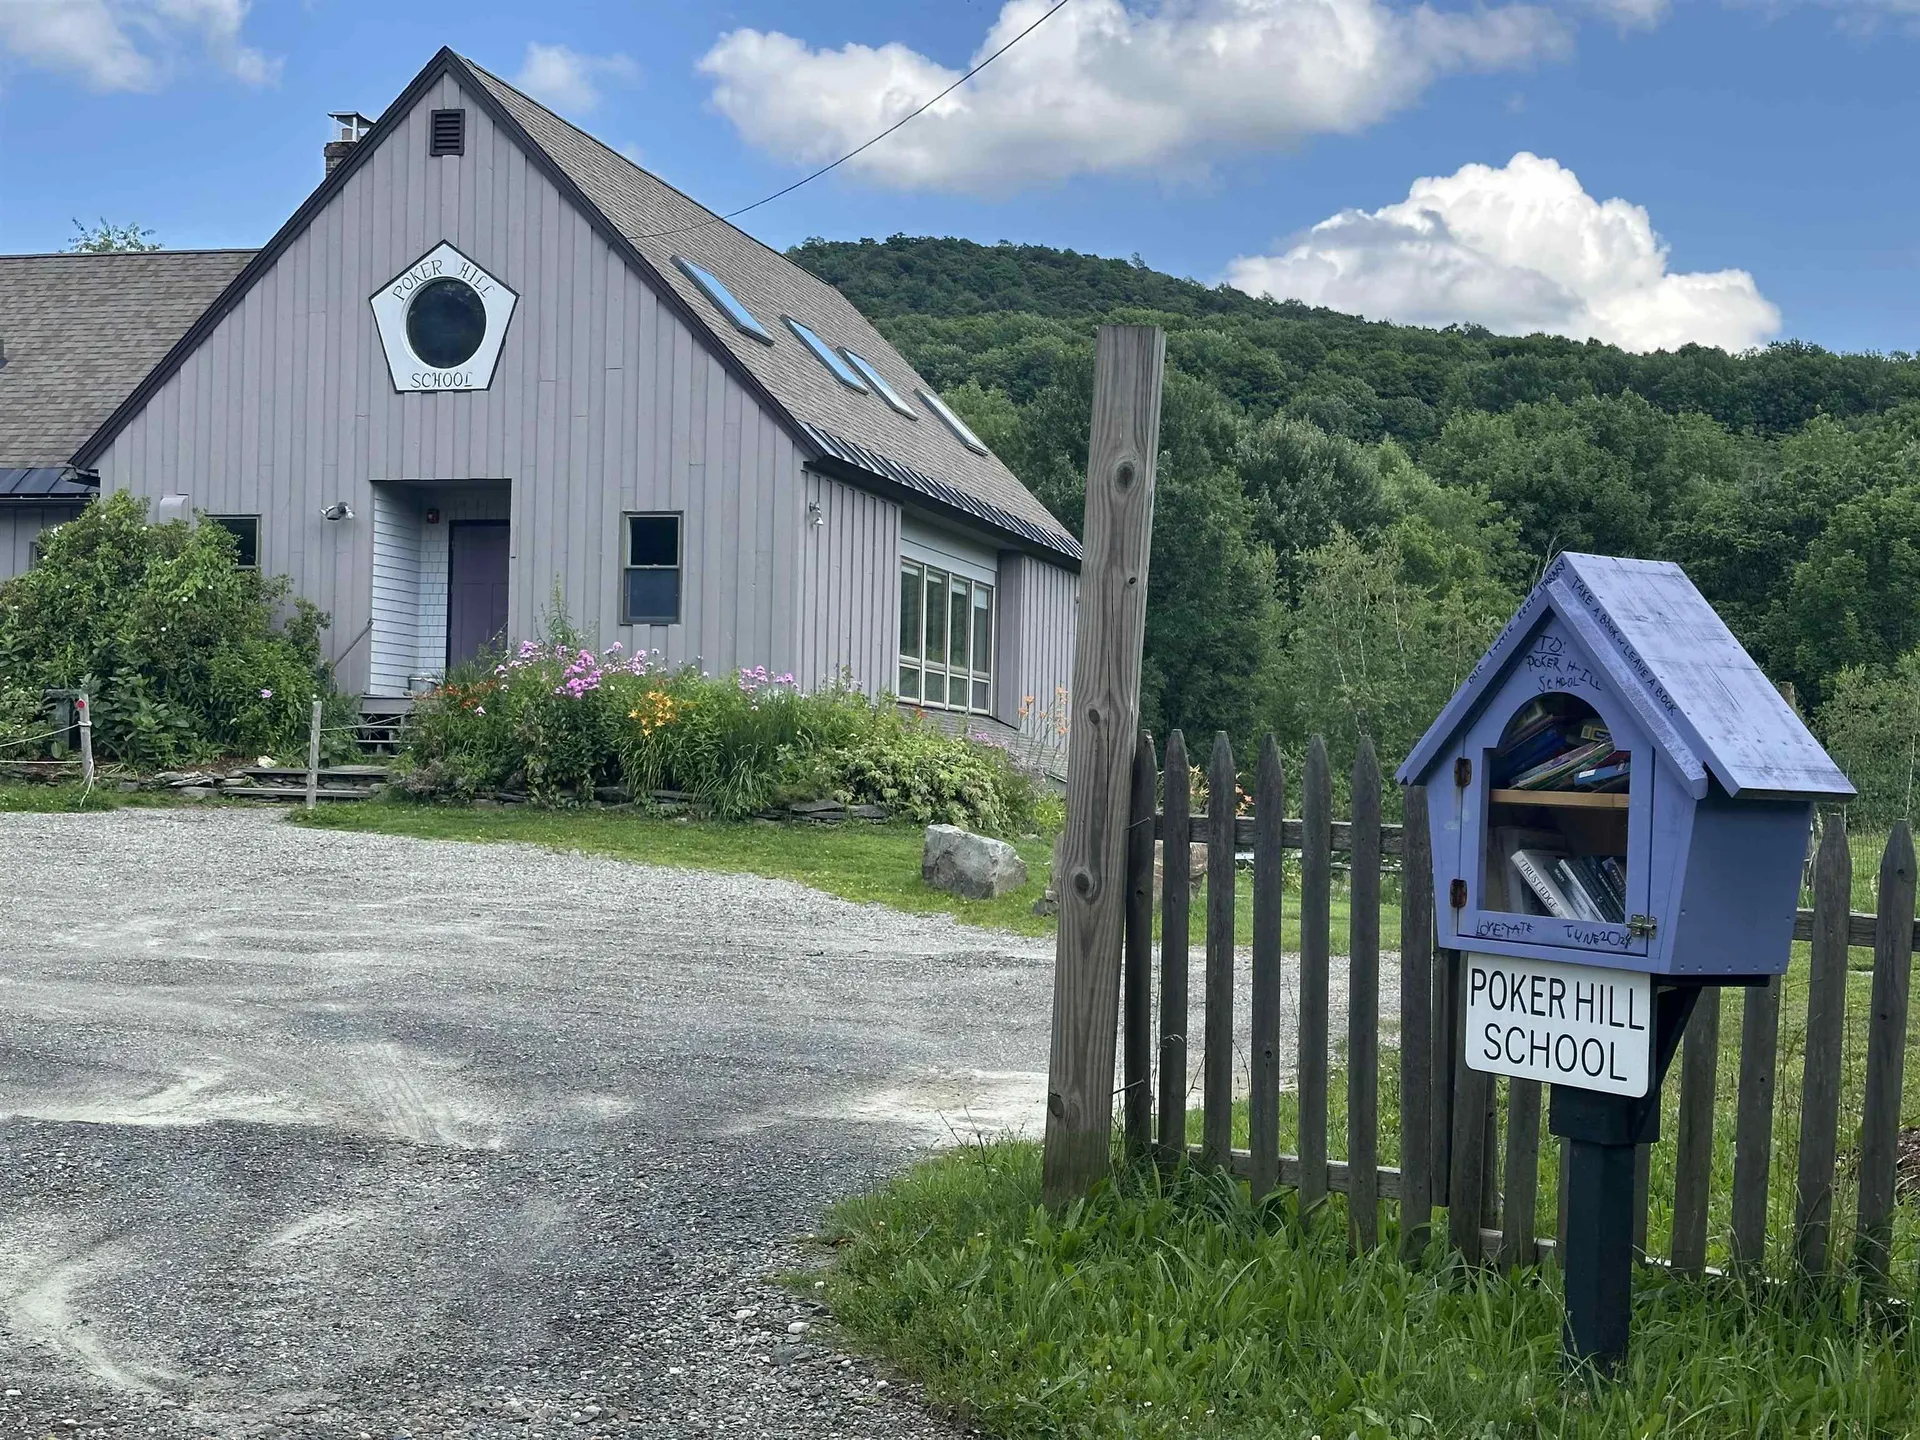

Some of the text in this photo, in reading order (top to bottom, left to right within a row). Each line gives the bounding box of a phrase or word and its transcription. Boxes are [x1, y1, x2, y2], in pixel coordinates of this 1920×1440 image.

[392, 259, 496, 302] POKER HILL
[410, 371, 474, 389] SCHOOL
[1572, 576, 1593, 605] TAKE
[1593, 607, 1601, 617] A
[1600, 614, 1619, 639] BOOK
[1623, 645, 1649, 678] LEAVE
[1646, 679, 1656, 690] A
[1656, 688, 1677, 716] BOOK
[1526, 655, 1602, 691] POKER HILL
[1538, 674, 1580, 692] SCHOOL
[1520, 859, 1559, 910] TRUST EDGE
[1471, 968, 1645, 1030] POKER HILL
[1483, 1023, 1627, 1081] SCHOOL
